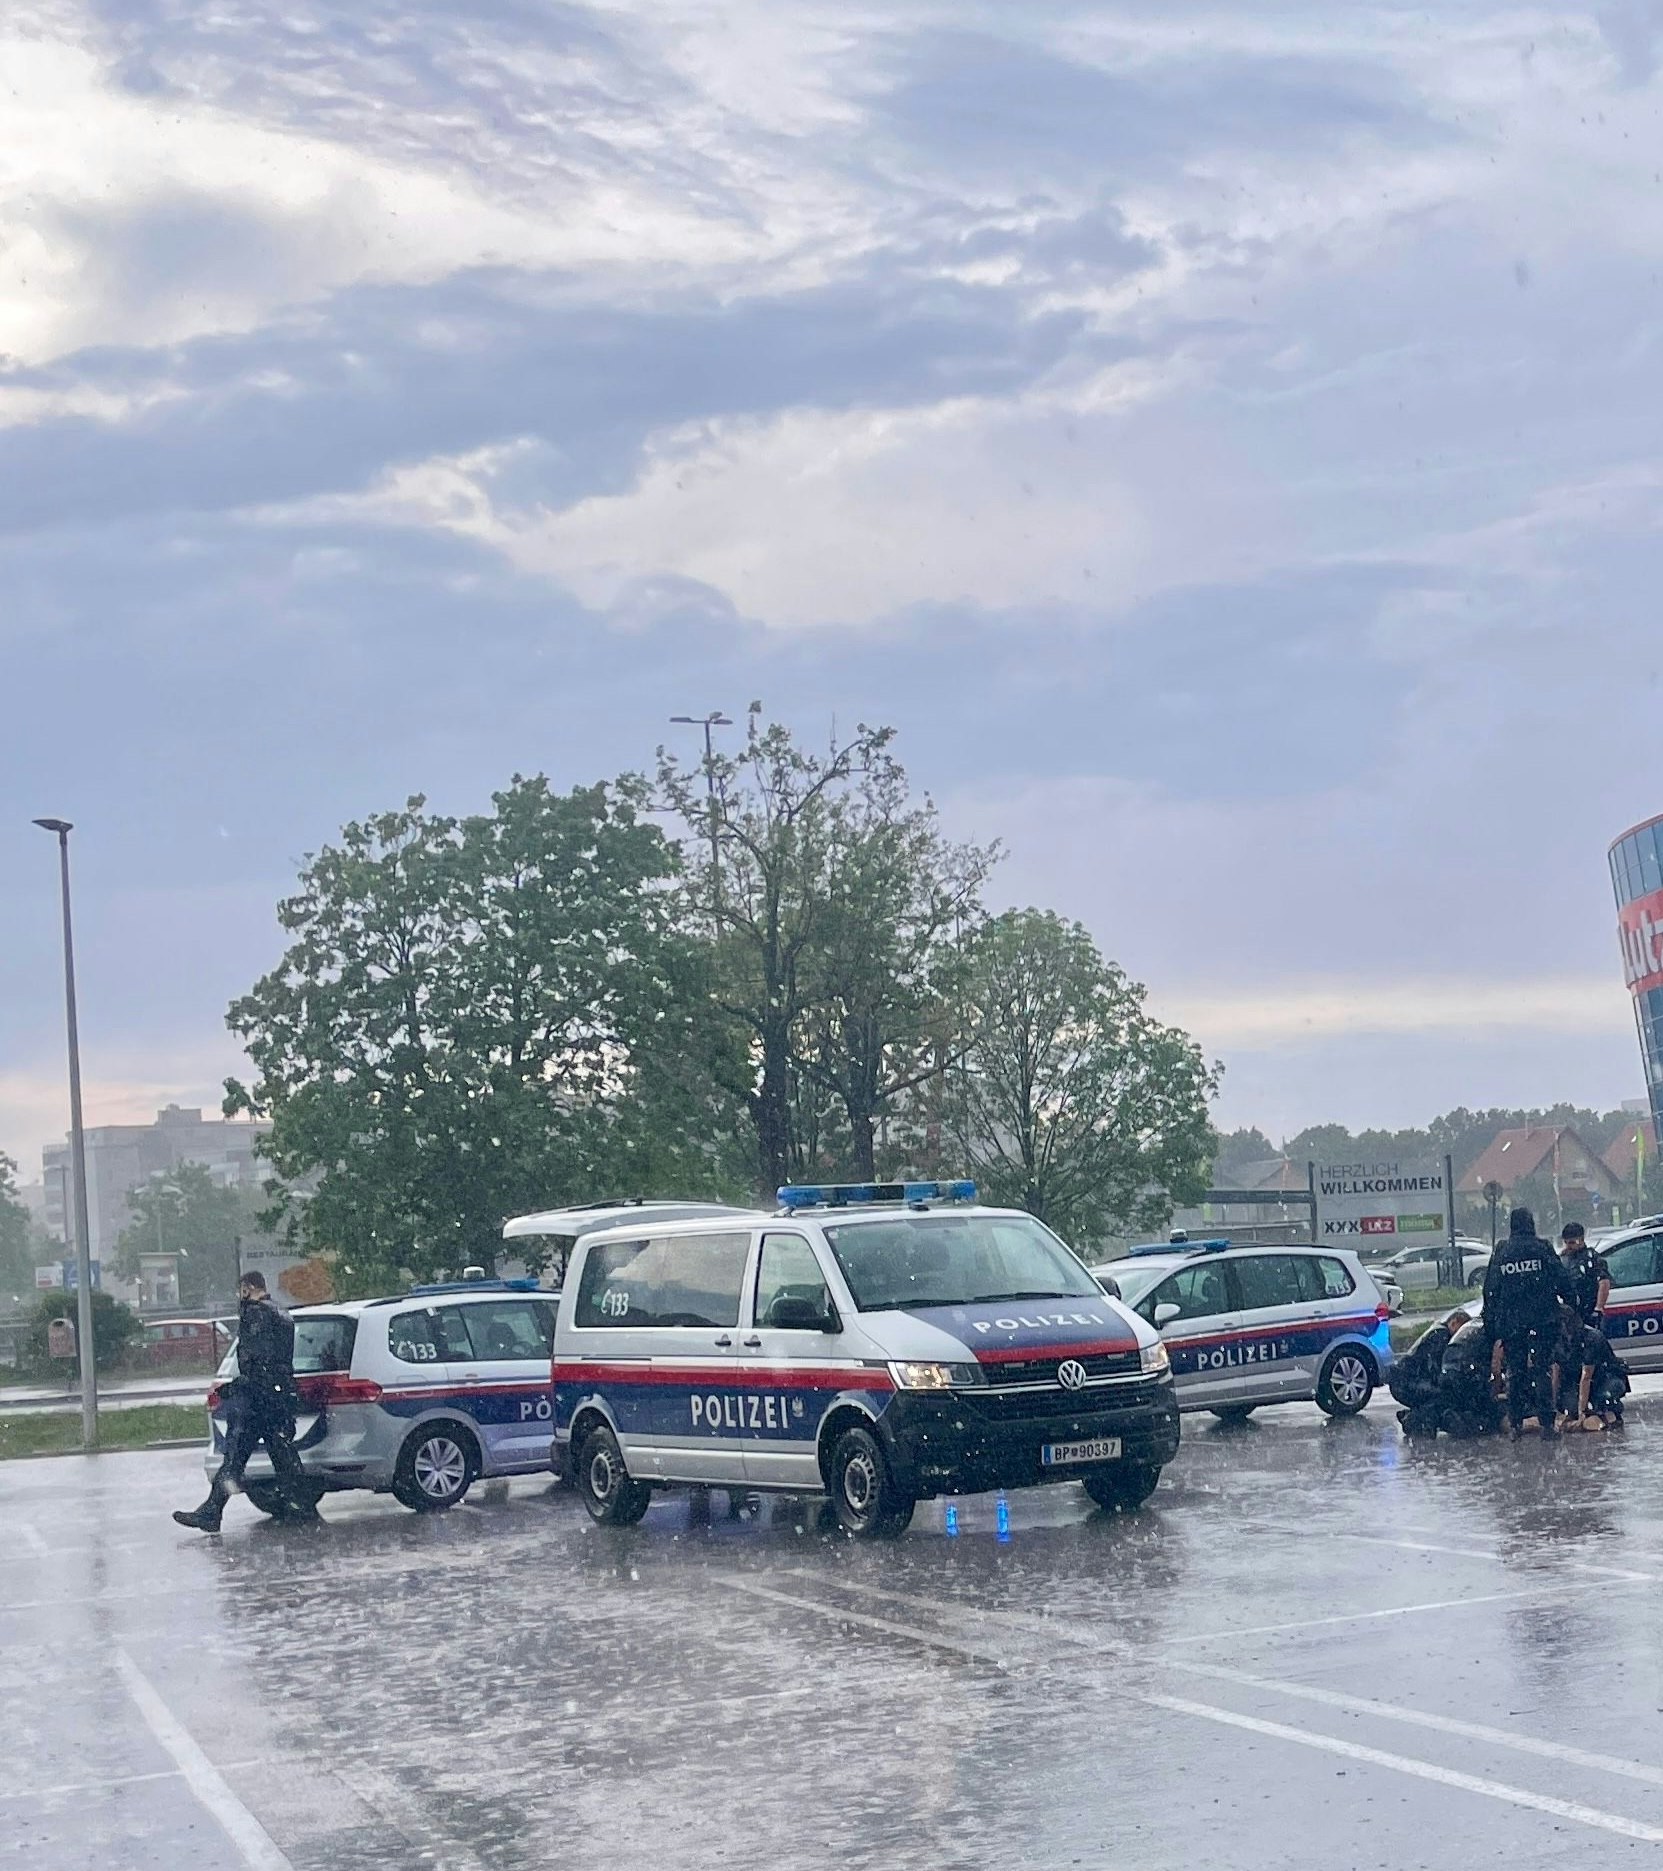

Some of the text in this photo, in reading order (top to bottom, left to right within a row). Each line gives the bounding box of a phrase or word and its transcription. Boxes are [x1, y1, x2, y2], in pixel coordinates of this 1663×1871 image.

[1320, 1163, 1398, 1178] HERZLICH
[1320, 1176, 1442, 1195] WILLKOMMEN
[1500, 1258, 1542, 1276] POLIZEI
[610, 1292, 630, 1316] 133
[972, 1314, 1105, 1334] POLIZEI
[410, 1342, 438, 1360] 133
[1197, 1343, 1278, 1370] POLIZEI
[690, 1394, 789, 1429] POLIZEI
[1080, 1442, 1116, 1458] 90397
